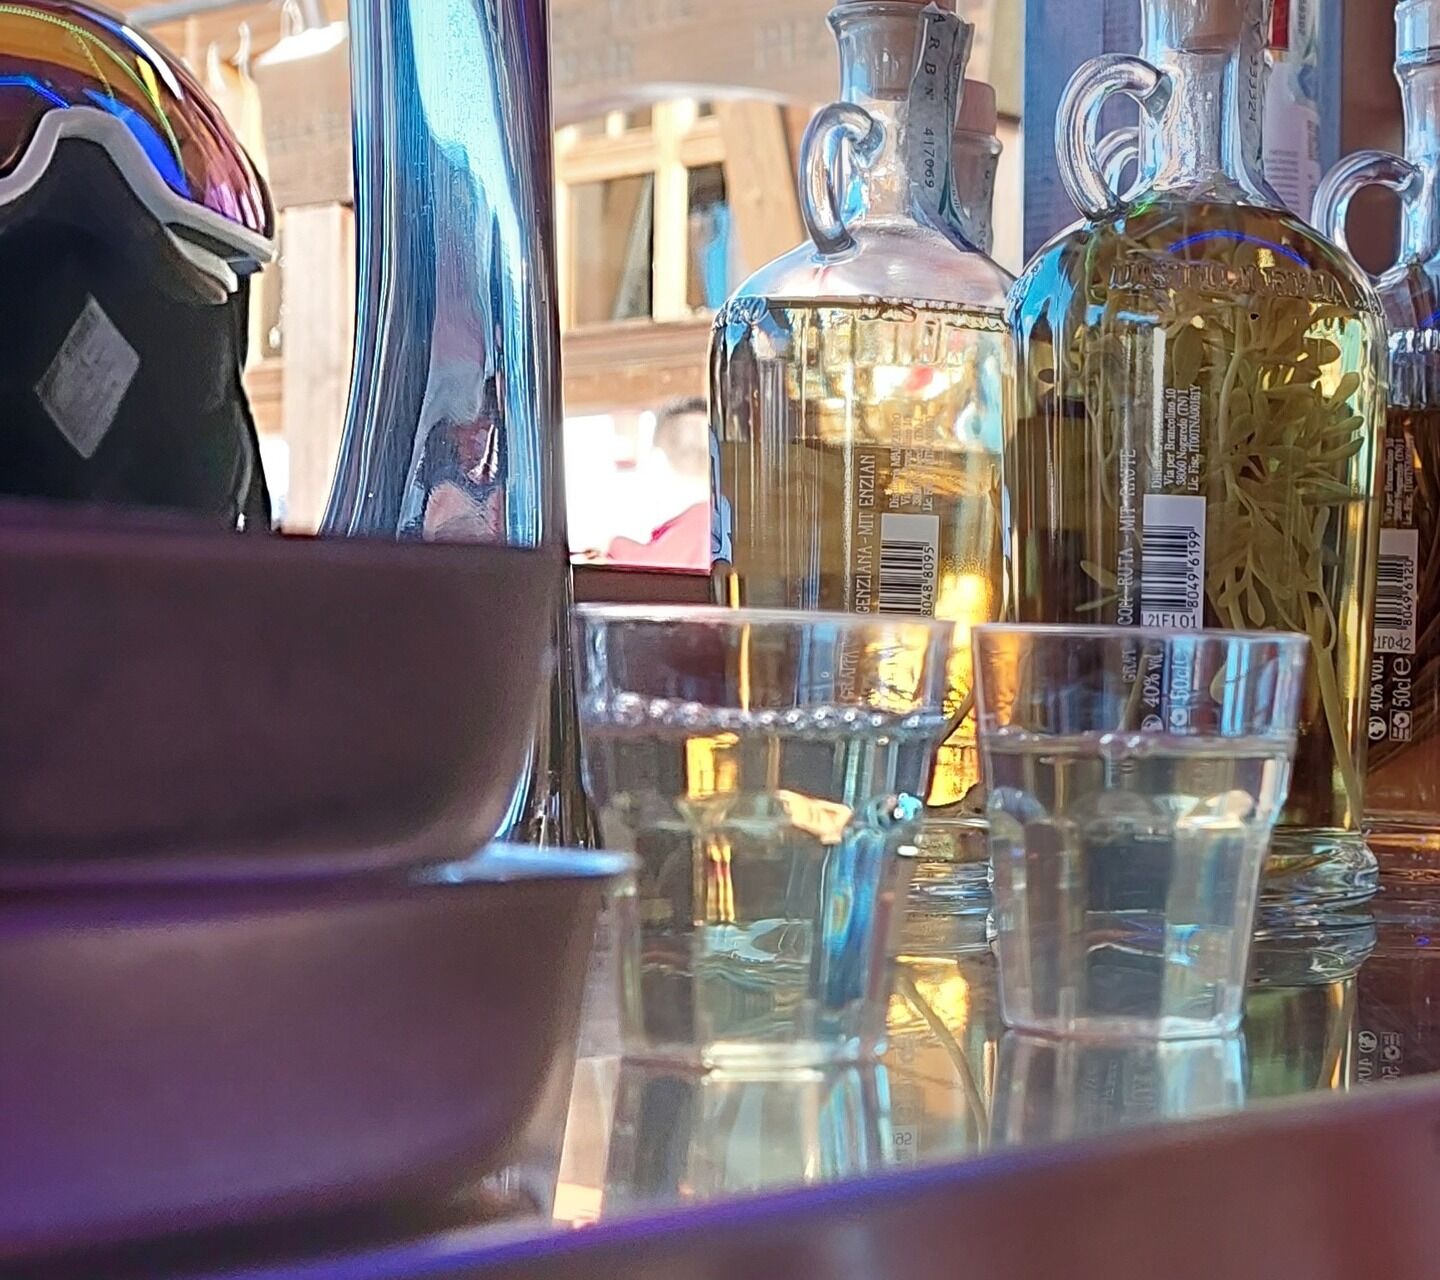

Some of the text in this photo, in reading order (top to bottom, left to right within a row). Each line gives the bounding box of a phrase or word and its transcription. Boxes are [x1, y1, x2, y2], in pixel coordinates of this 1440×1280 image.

[923, 127, 935, 188] 417069
[1177, 396, 1189, 416] (TN)
[1164, 388, 1177, 486] Via per Brancolino 10
[1177, 418, 1189, 458] Nogaredo
[859, 454, 875, 508] ENZIAN
[857, 513, 873, 536] MIT
[1119, 507, 1136, 531] MIT
[856, 546, 873, 615] GENZIANA
[922, 546, 934, 616] 8048 8095
[1117, 547, 1134, 586] RUTA
[1187, 531, 1201, 609] 8049 6199
[1402, 559, 1414, 626] 8049 6120
[1143, 673, 1160, 708] 40%
[1369, 683, 1384, 712] 40%
